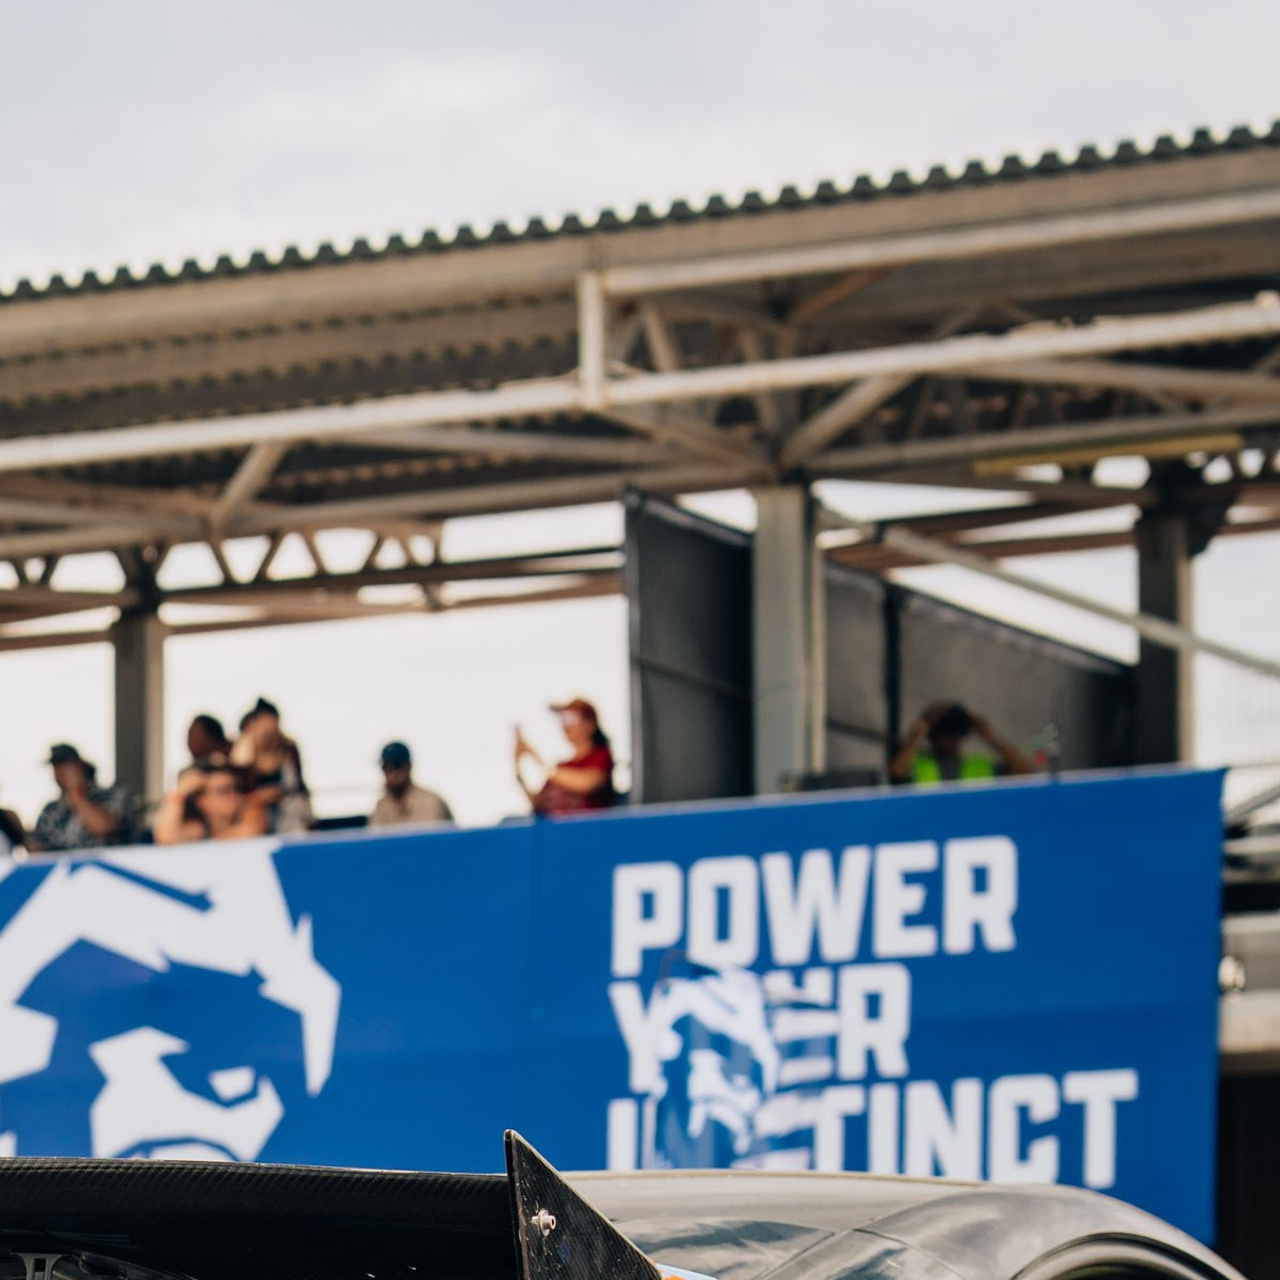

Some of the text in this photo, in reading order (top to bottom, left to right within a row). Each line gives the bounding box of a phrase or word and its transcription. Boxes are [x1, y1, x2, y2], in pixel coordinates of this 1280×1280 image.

[611, 835, 1018, 978] POWER
[607, 962, 912, 1094] YR
[607, 1068, 1138, 1189] ITINCT
